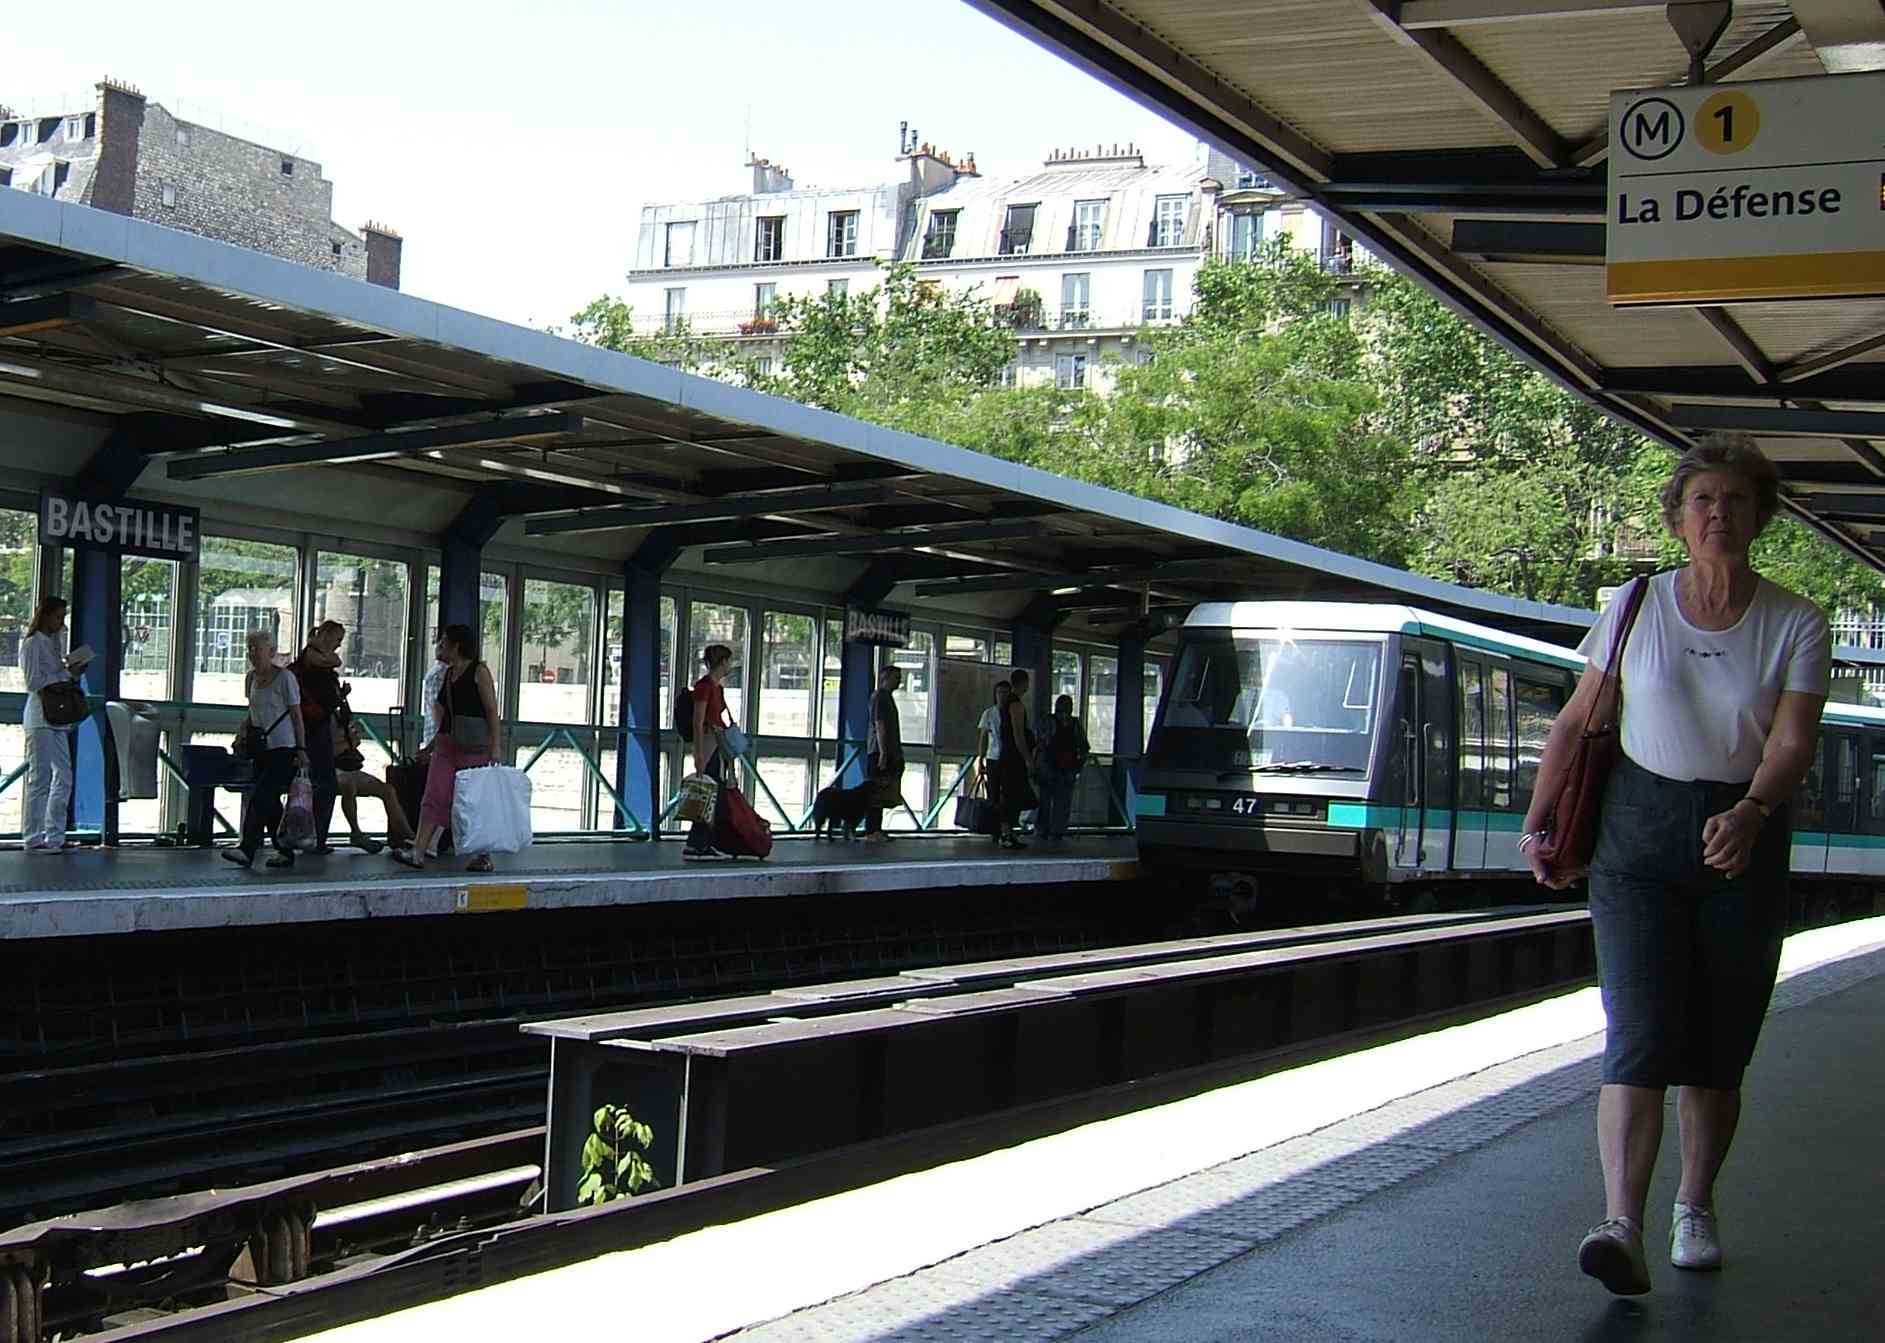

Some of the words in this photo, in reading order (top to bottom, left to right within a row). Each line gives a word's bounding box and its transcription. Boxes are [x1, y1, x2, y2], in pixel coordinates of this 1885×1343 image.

[1634, 110, 1670, 147] M
[1713, 104, 1733, 143] 1
[1618, 193, 1661, 225] La
[1675, 184, 1842, 222] Défense
[47, 497, 194, 553] BASTILLE
[1232, 797, 1256, 814] 47
